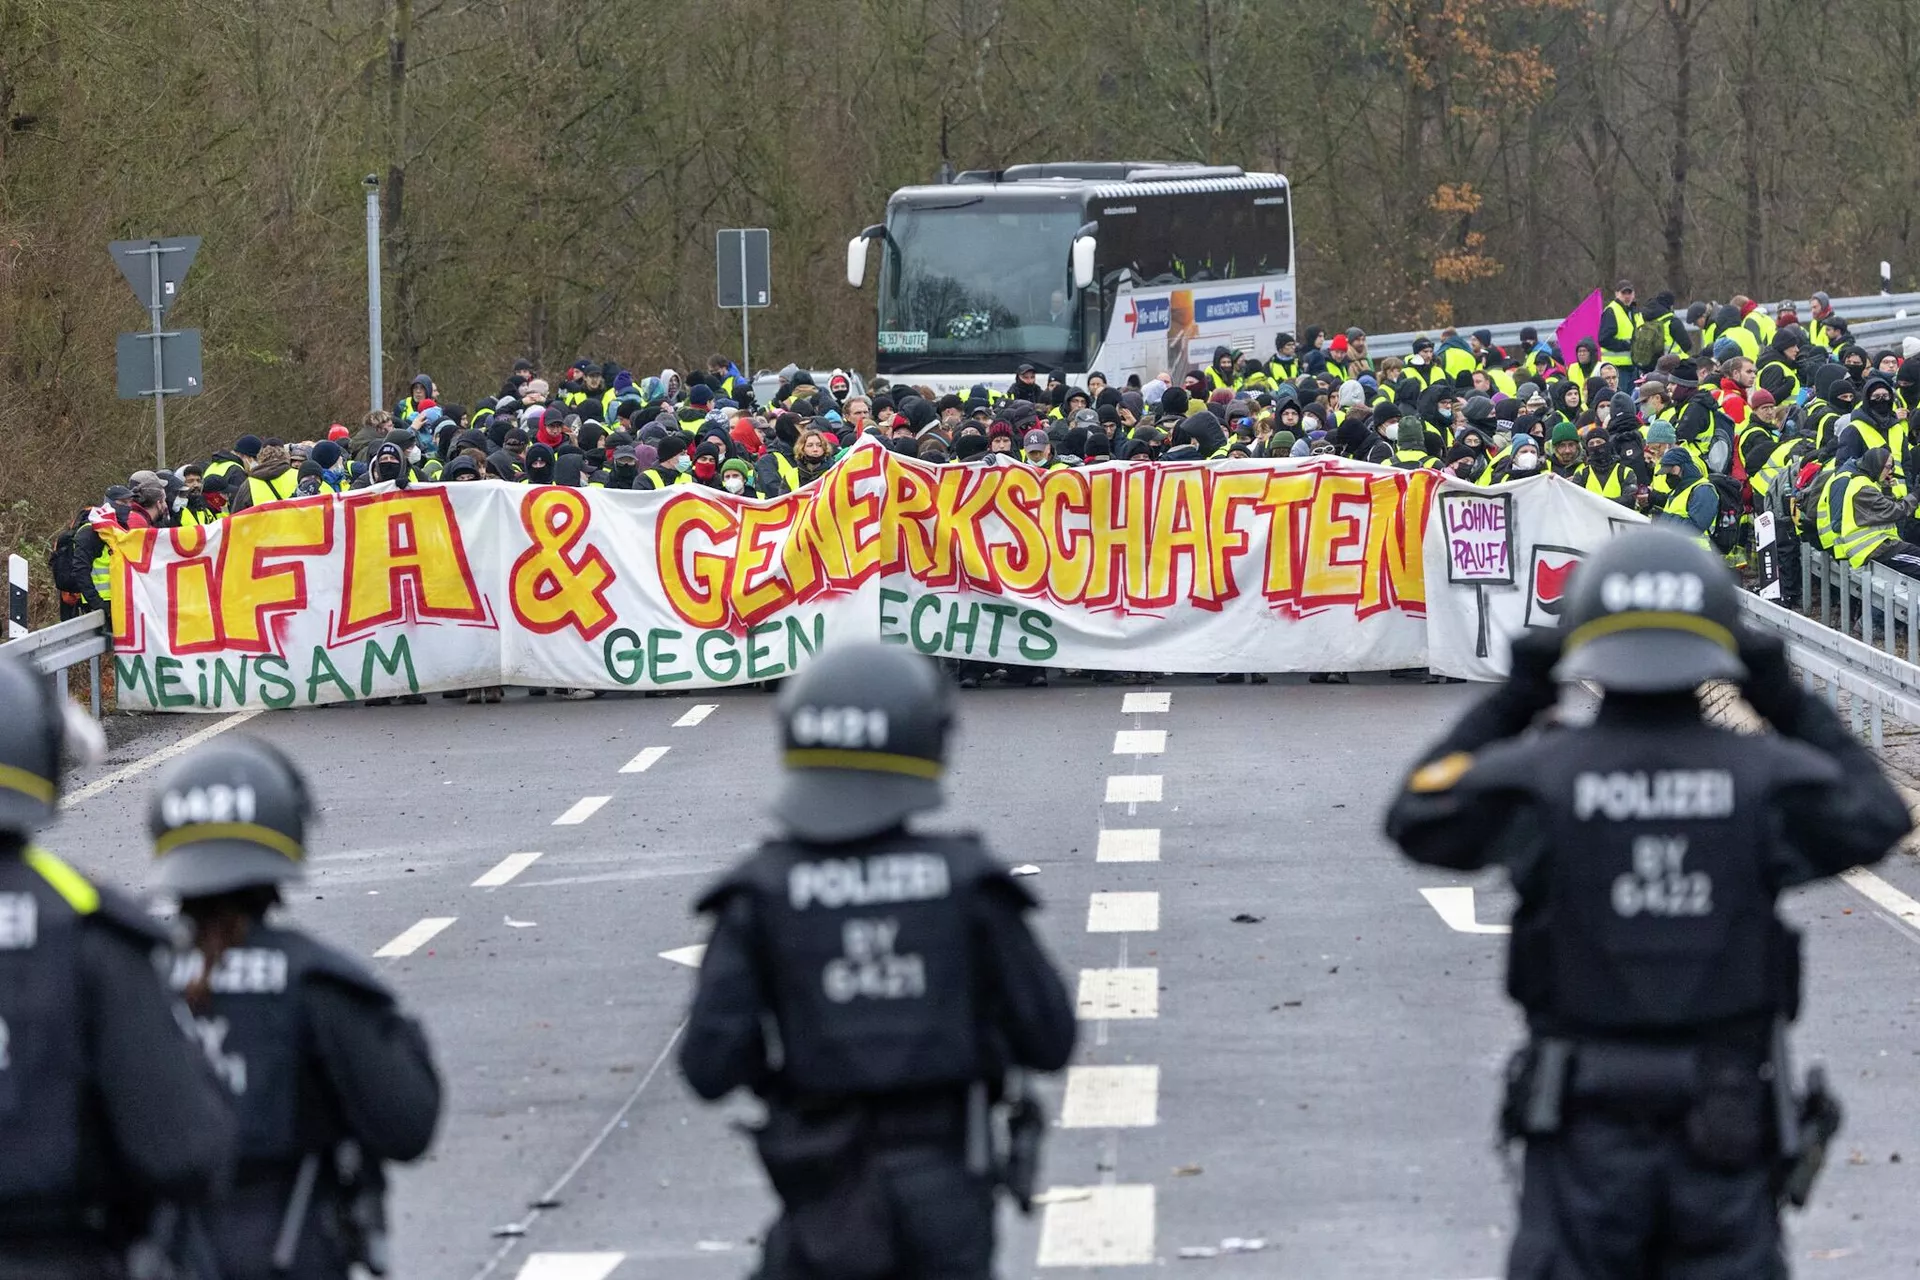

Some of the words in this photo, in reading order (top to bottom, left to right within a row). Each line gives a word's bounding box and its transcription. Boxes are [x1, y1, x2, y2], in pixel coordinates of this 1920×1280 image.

[1448, 500, 1506, 534] LÖHNE
[508, 484, 618, 642] &
[655, 443, 1441, 630] GEWERKSCHAFTEN
[1452, 539, 1508, 574] RAUF!
[603, 612, 825, 685] GEGEN
[1573, 769, 1735, 821] POLIZEI
[788, 853, 951, 910] POLIZEI
[1632, 834, 1688, 881] BY
[841, 915, 898, 961] BY
